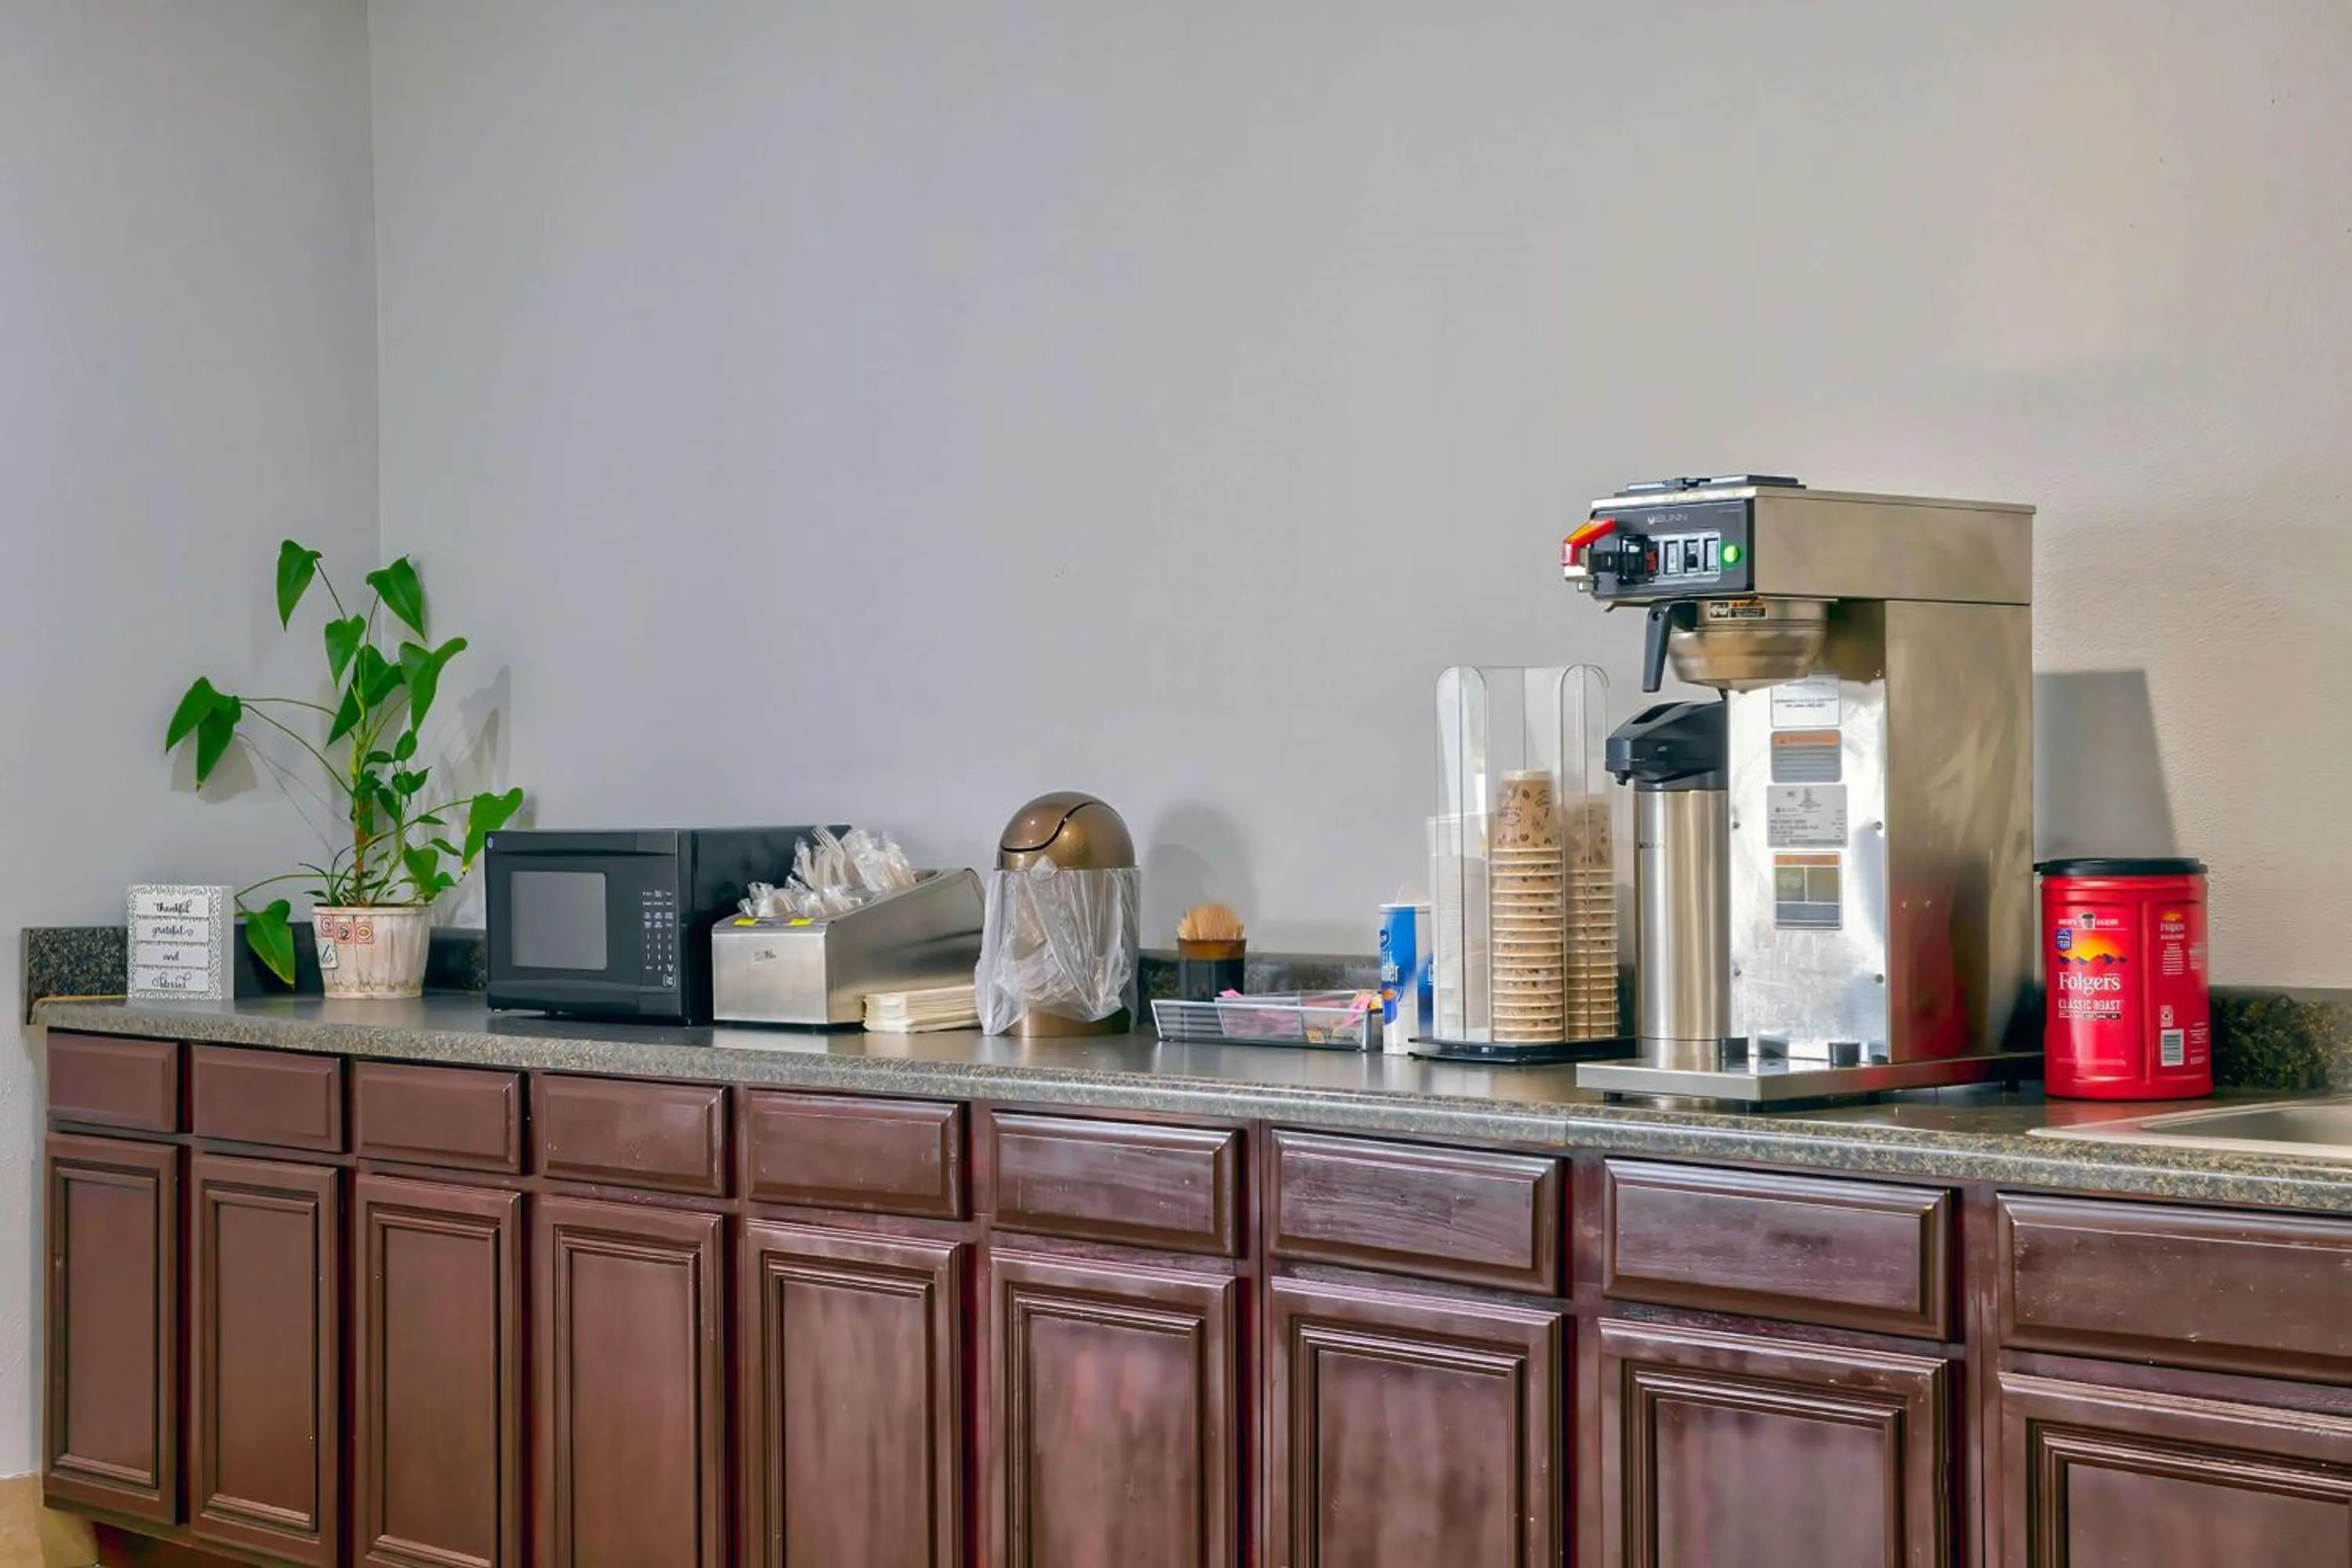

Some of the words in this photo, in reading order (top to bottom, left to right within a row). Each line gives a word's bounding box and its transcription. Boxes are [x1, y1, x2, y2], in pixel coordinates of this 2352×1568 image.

[163, 952, 180, 960] and
[2058, 971, 2121, 995] Folgers
[2058, 999, 2092, 1010] CLASSIC
[2092, 1000, 2121, 1011] ROAST
